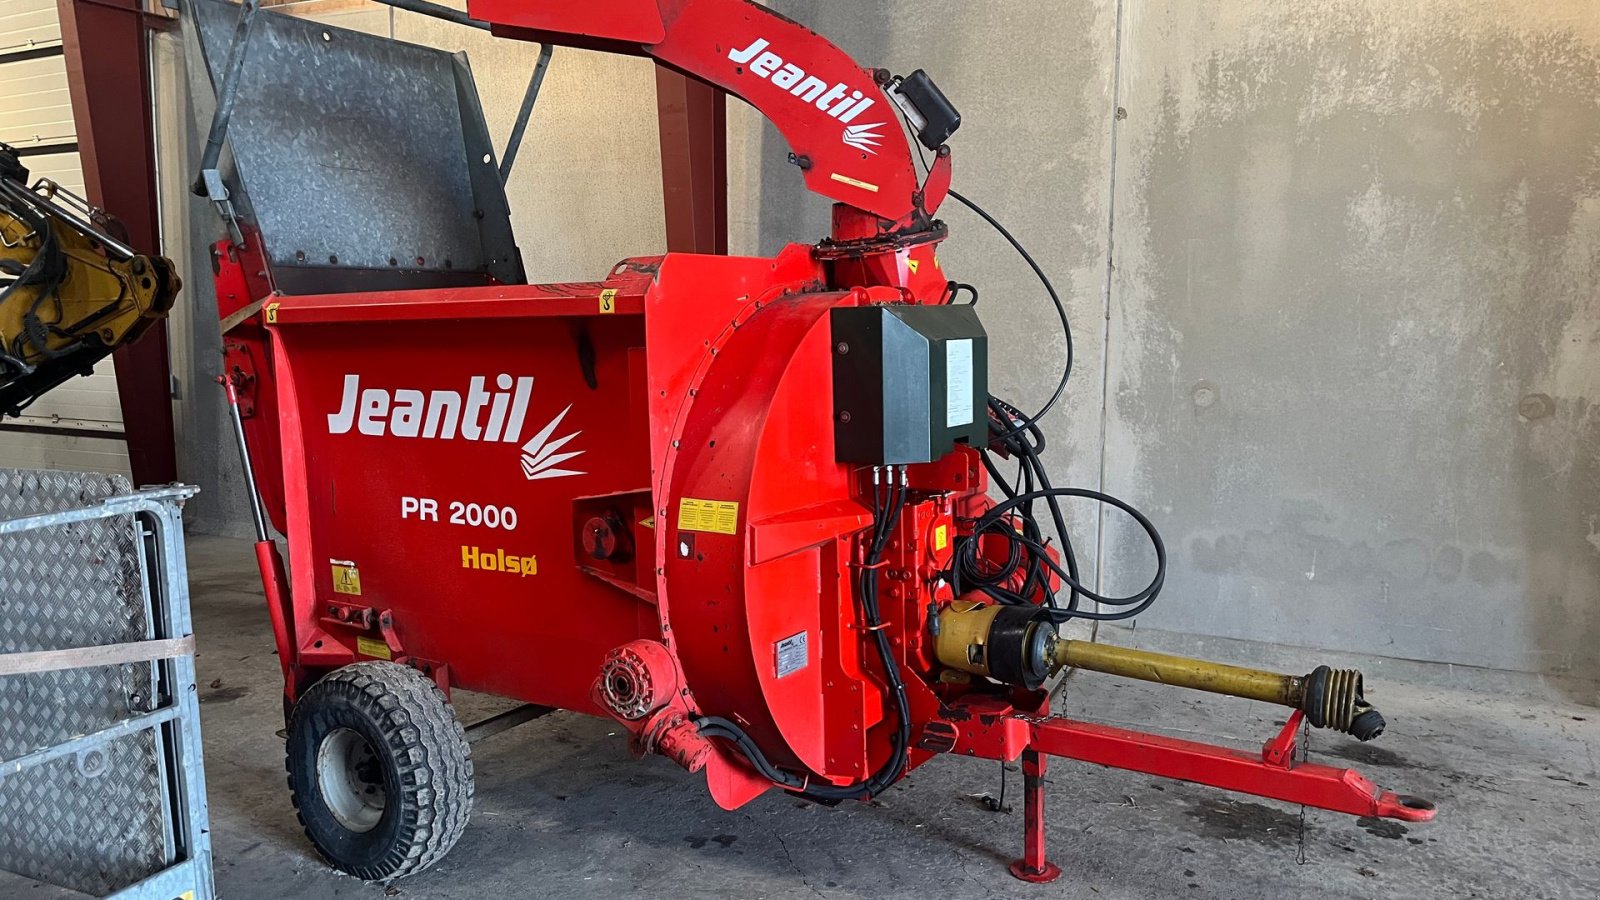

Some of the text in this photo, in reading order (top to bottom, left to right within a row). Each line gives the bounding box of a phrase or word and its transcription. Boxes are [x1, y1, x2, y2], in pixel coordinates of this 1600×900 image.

[728, 38, 875, 123] Jeantil
[327, 373, 534, 442] Jeantil
[401, 496, 517, 530] PR 2000
[461, 546, 537, 577] Holsø
